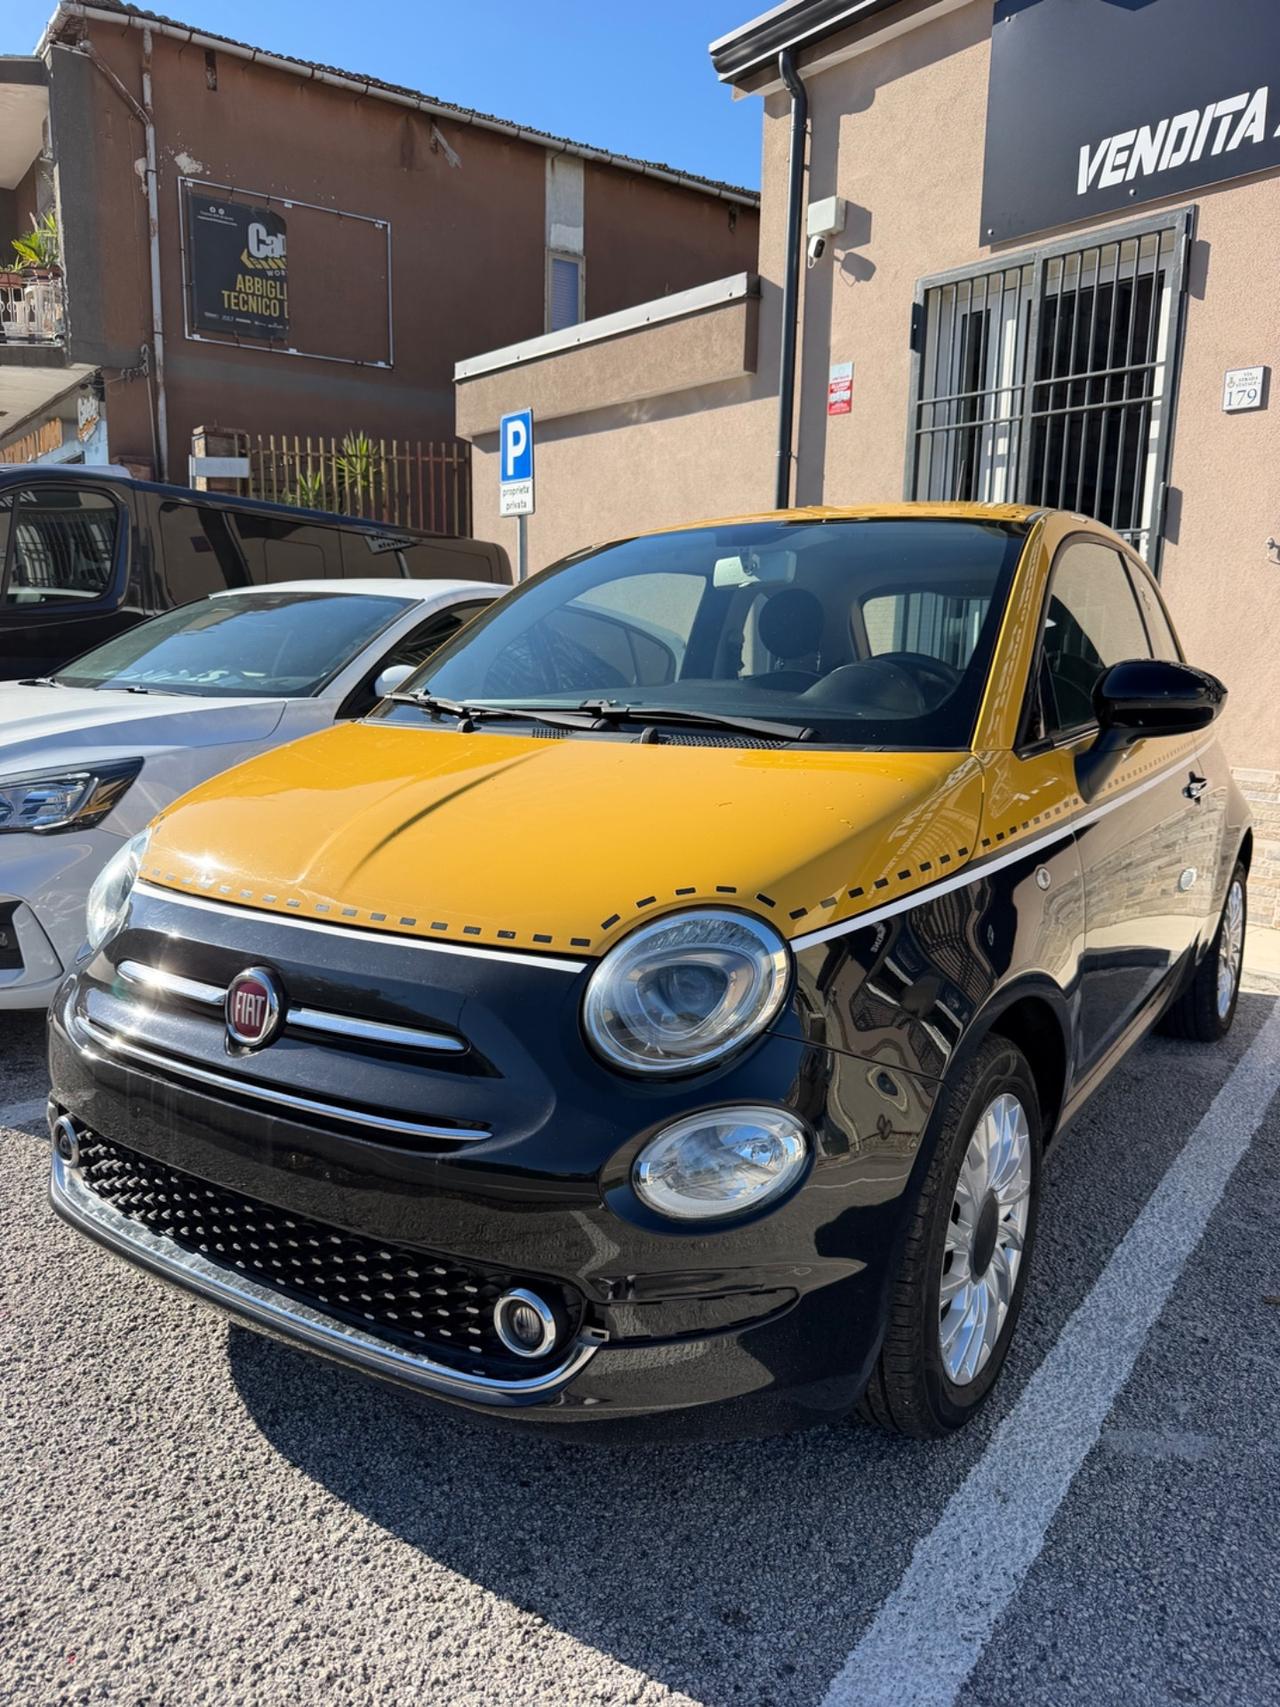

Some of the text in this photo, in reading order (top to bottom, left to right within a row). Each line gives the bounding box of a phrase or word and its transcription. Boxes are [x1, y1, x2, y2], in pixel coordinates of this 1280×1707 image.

[1077, 86, 1268, 195] VENDITA
[221, 290, 279, 317] TECNICO
[1226, 388, 1257, 406] 179
[507, 420, 527, 476] P
[235, 991, 265, 1027] FIAT
